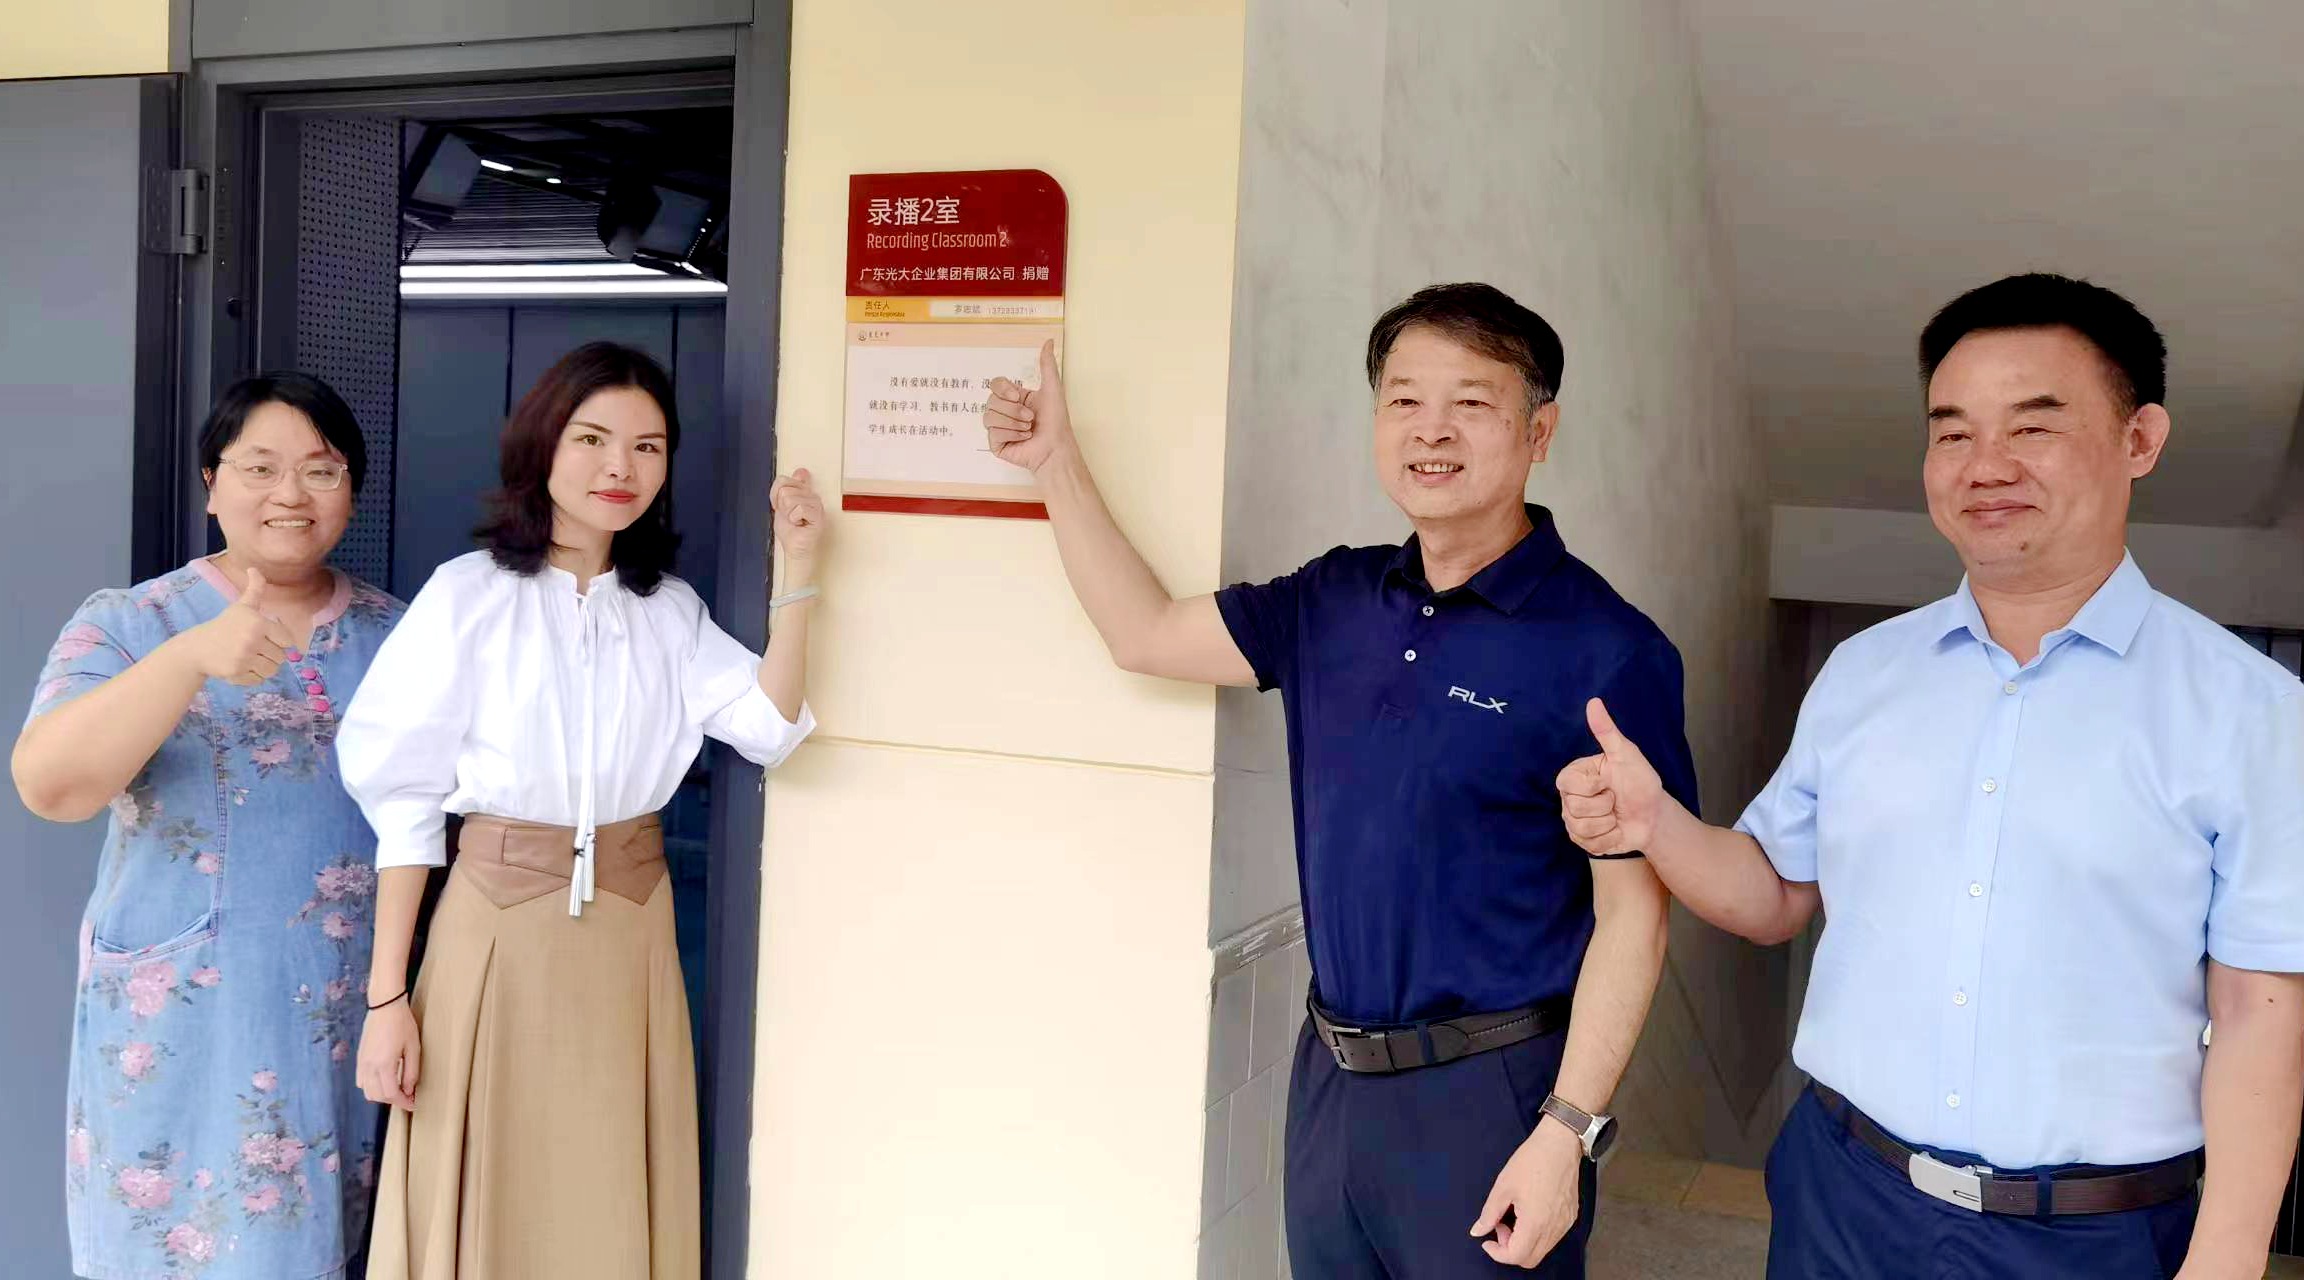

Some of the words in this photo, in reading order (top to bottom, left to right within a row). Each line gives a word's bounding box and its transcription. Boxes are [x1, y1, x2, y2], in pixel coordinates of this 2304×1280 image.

[867, 195, 960, 226] 录播2室
[867, 231, 929, 251] Recording
[931, 231, 997, 248] Classroom
[1000, 231, 1007, 248] 2
[860, 265, 1015, 281] 广东光大企业集团有限公司
[1022, 265, 1049, 281] 捐赠
[1448, 685, 1509, 714] RLX
